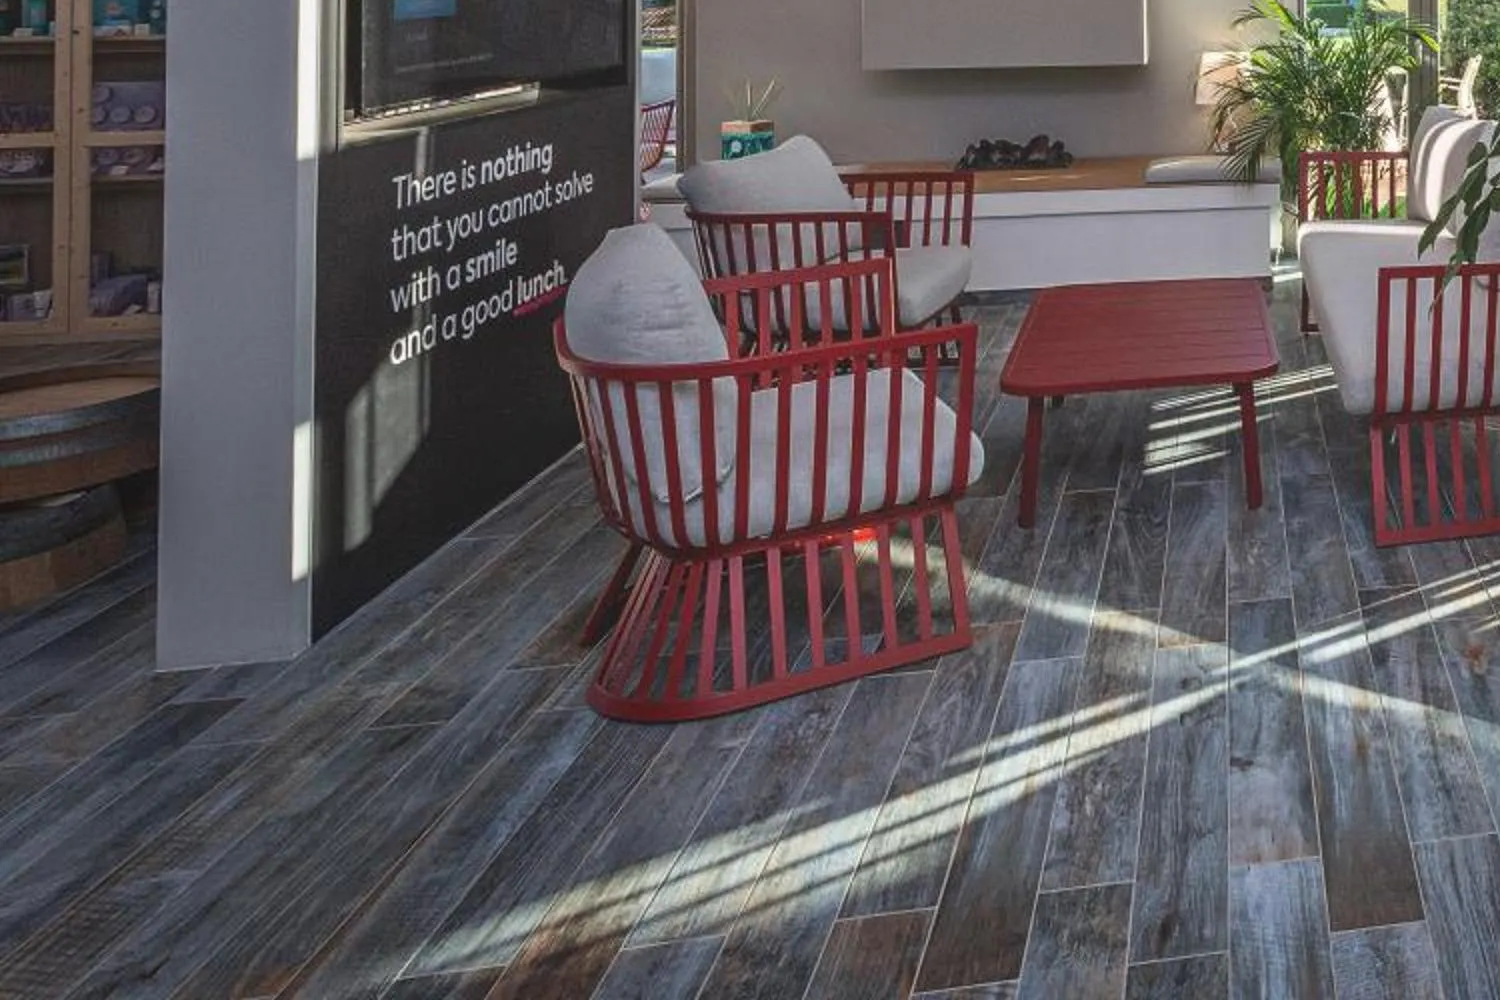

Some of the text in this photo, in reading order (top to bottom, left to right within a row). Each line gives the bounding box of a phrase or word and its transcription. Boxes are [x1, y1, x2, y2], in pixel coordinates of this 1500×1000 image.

[392, 142, 553, 209] There is nothing
[392, 170, 593, 262] that you cannot solve
[390, 238, 518, 313] with a smile
[390, 314, 436, 364] and
[443, 314, 456, 340] a
[462, 281, 512, 339] good
